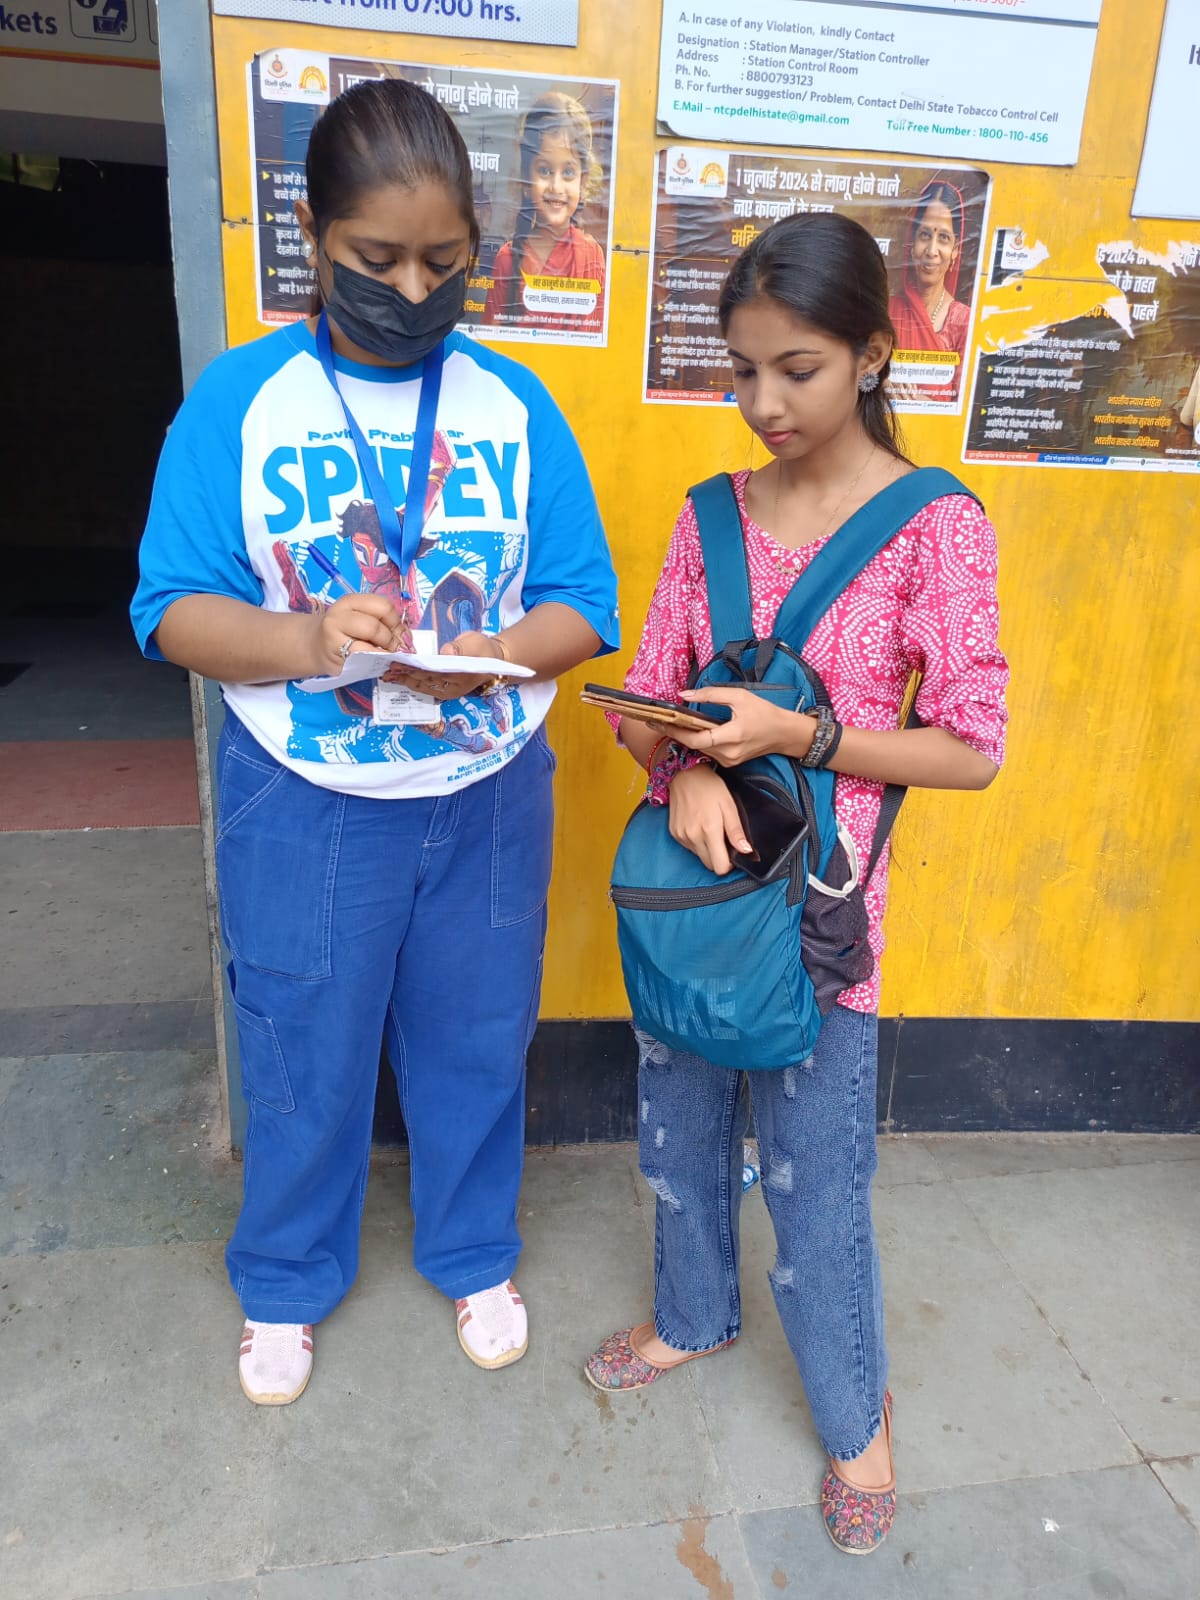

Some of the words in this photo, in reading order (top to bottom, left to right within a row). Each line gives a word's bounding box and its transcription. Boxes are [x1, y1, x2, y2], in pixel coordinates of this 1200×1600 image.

[0, 5, 58, 34] kets
[403, 0, 474, 18] 07:00
[480, 0, 521, 22] hrs.
[679, 12, 690, 23] A.
[692, 13, 702, 24] In
[704, 15, 728, 27] case
[730, 16, 743, 28] of
[744, 19, 763, 32] any
[766, 20, 816, 37] Violation,
[820, 25, 852, 41] kindly
[854, 28, 895, 43] Contact
[676, 49, 719, 63] Address
[747, 55, 785, 69] Station
[787, 58, 826, 73] Control
[828, 63, 858, 76] Room
[677, 33, 740, 50] Designation
[749, 40, 787, 55] Station
[789, 44, 876, 62] Manager/Station
[878, 51, 930, 67] Controller
[675, 64, 691, 76] Ph.
[693, 65, 711, 78] No.
[746, 71, 814, 87] 8800793123
[436, 82, 469, 113] लागू
[468, 81, 493, 108] होने
[494, 84, 519, 110] वाले
[674, 79, 684, 90] B.
[686, 80, 704, 92] For
[706, 82, 743, 96] further
[745, 86, 808, 102] suggestion/
[810, 91, 855, 107] Problem,
[857, 95, 897, 109] Contact
[899, 98, 925, 112] Delhi
[927, 101, 954, 115] State
[956, 104, 998, 118] Tobacco
[1000, 107, 1038, 122] Control
[1039, 111, 1059, 123] Cell
[673, 100, 703, 113] E.Mail
[714, 105, 850, 126] ntcpdelhistate@gmail.com
[907, 122, 929, 134] Free
[931, 124, 971, 137] Number
[979, 127, 1049, 144] 1800-110-456
[736, 167, 742, 187] 1
[743, 166, 778, 195] जुलाई
[779, 170, 809, 191] 2024
[810, 168, 823, 192] से
[824, 173, 852, 201] लागू
[852, 171, 876, 196] होने
[876, 173, 901, 197] वाले
[733, 198, 754, 218] नए
[754, 196, 796, 224] कानूनों
[1132, 275, 1158, 294] तहत
